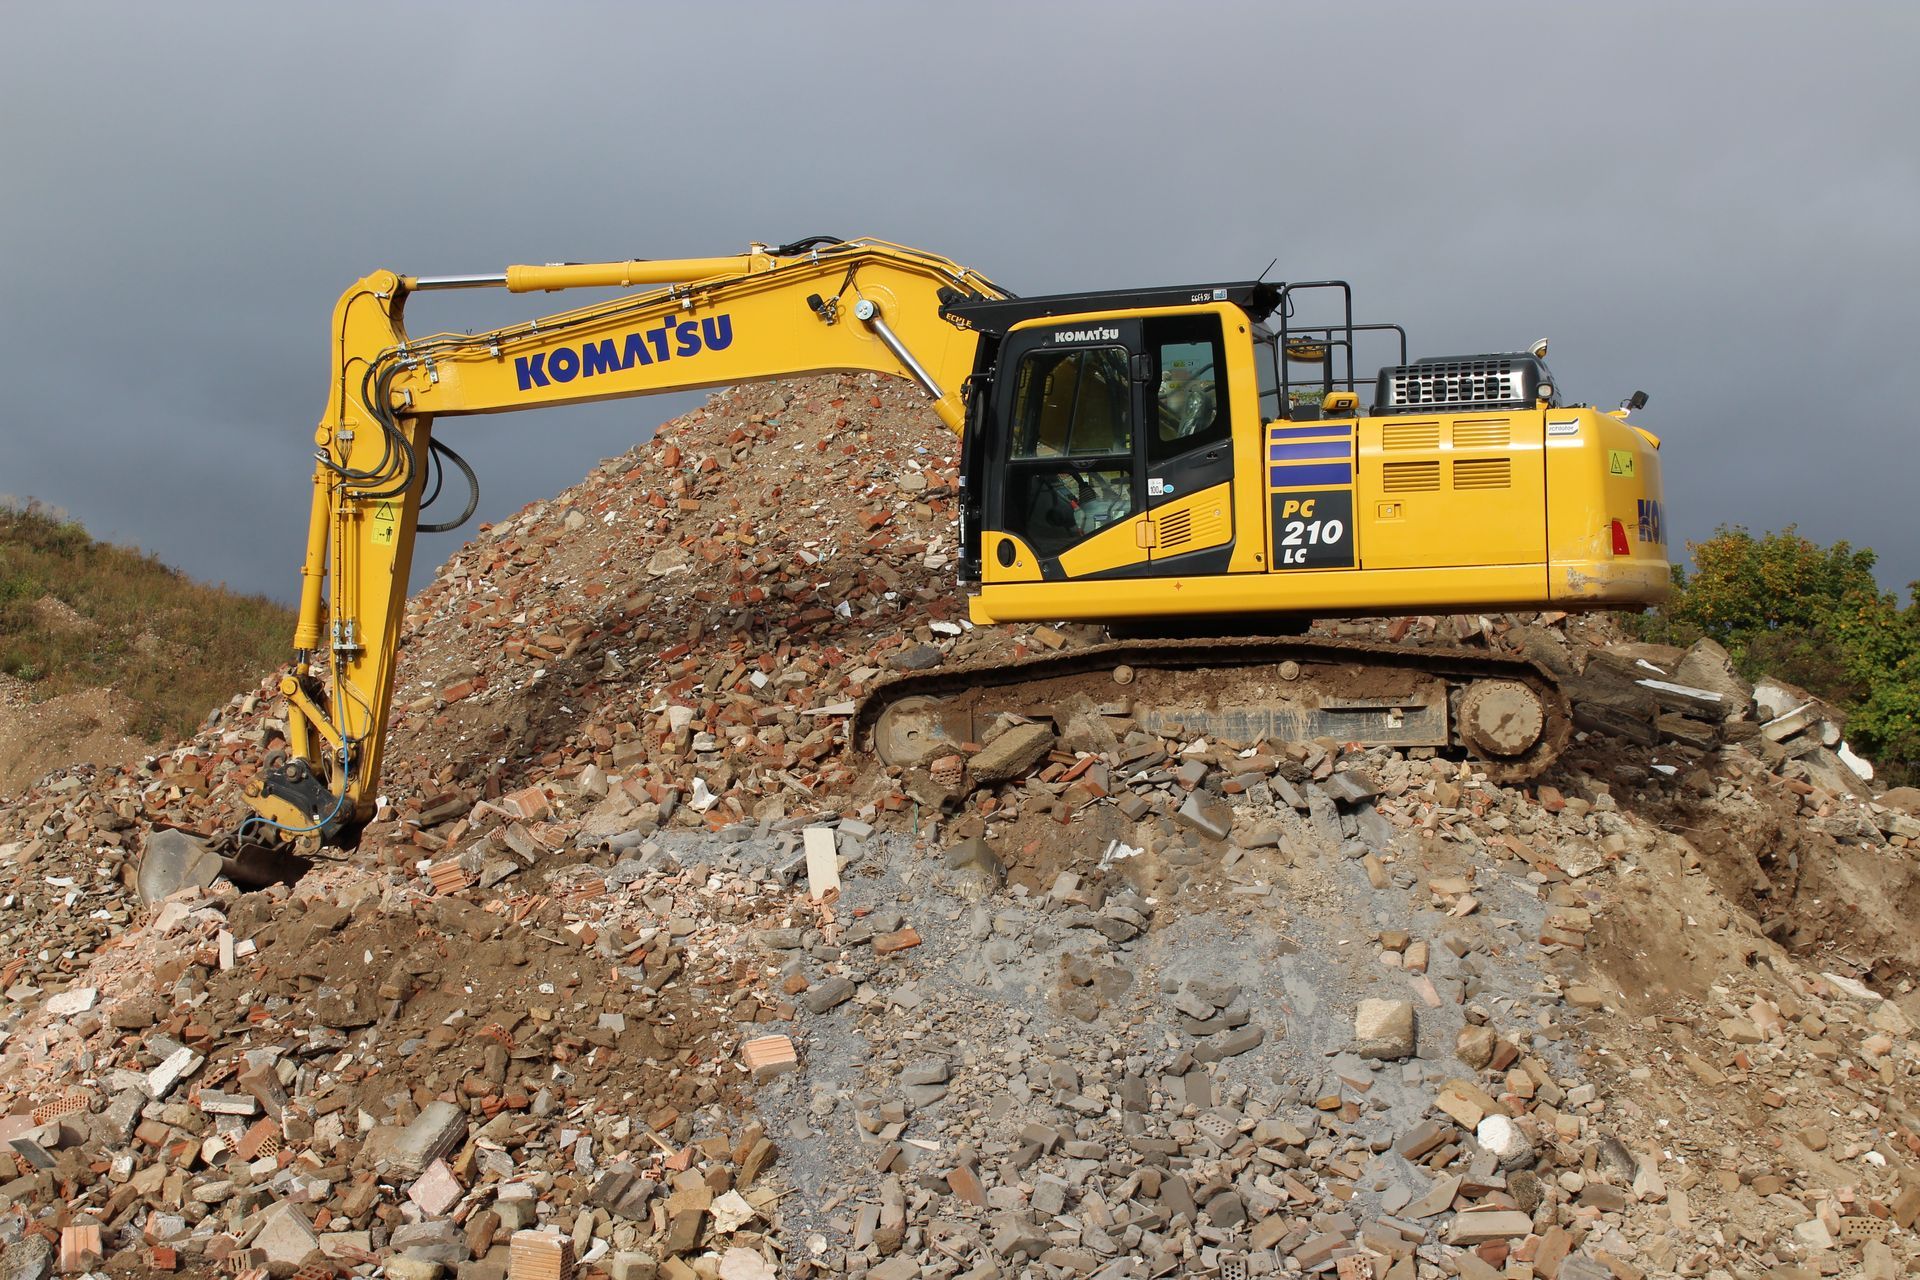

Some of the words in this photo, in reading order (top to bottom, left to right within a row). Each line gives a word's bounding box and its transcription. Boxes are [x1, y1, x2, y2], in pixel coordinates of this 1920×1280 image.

[1055, 327, 1119, 343] KOMATSU
[514, 313, 733, 391] KOMATSU
[1282, 499, 1316, 519] PC
[1281, 519, 1344, 546] 210
[1283, 548, 1307, 564] LC
